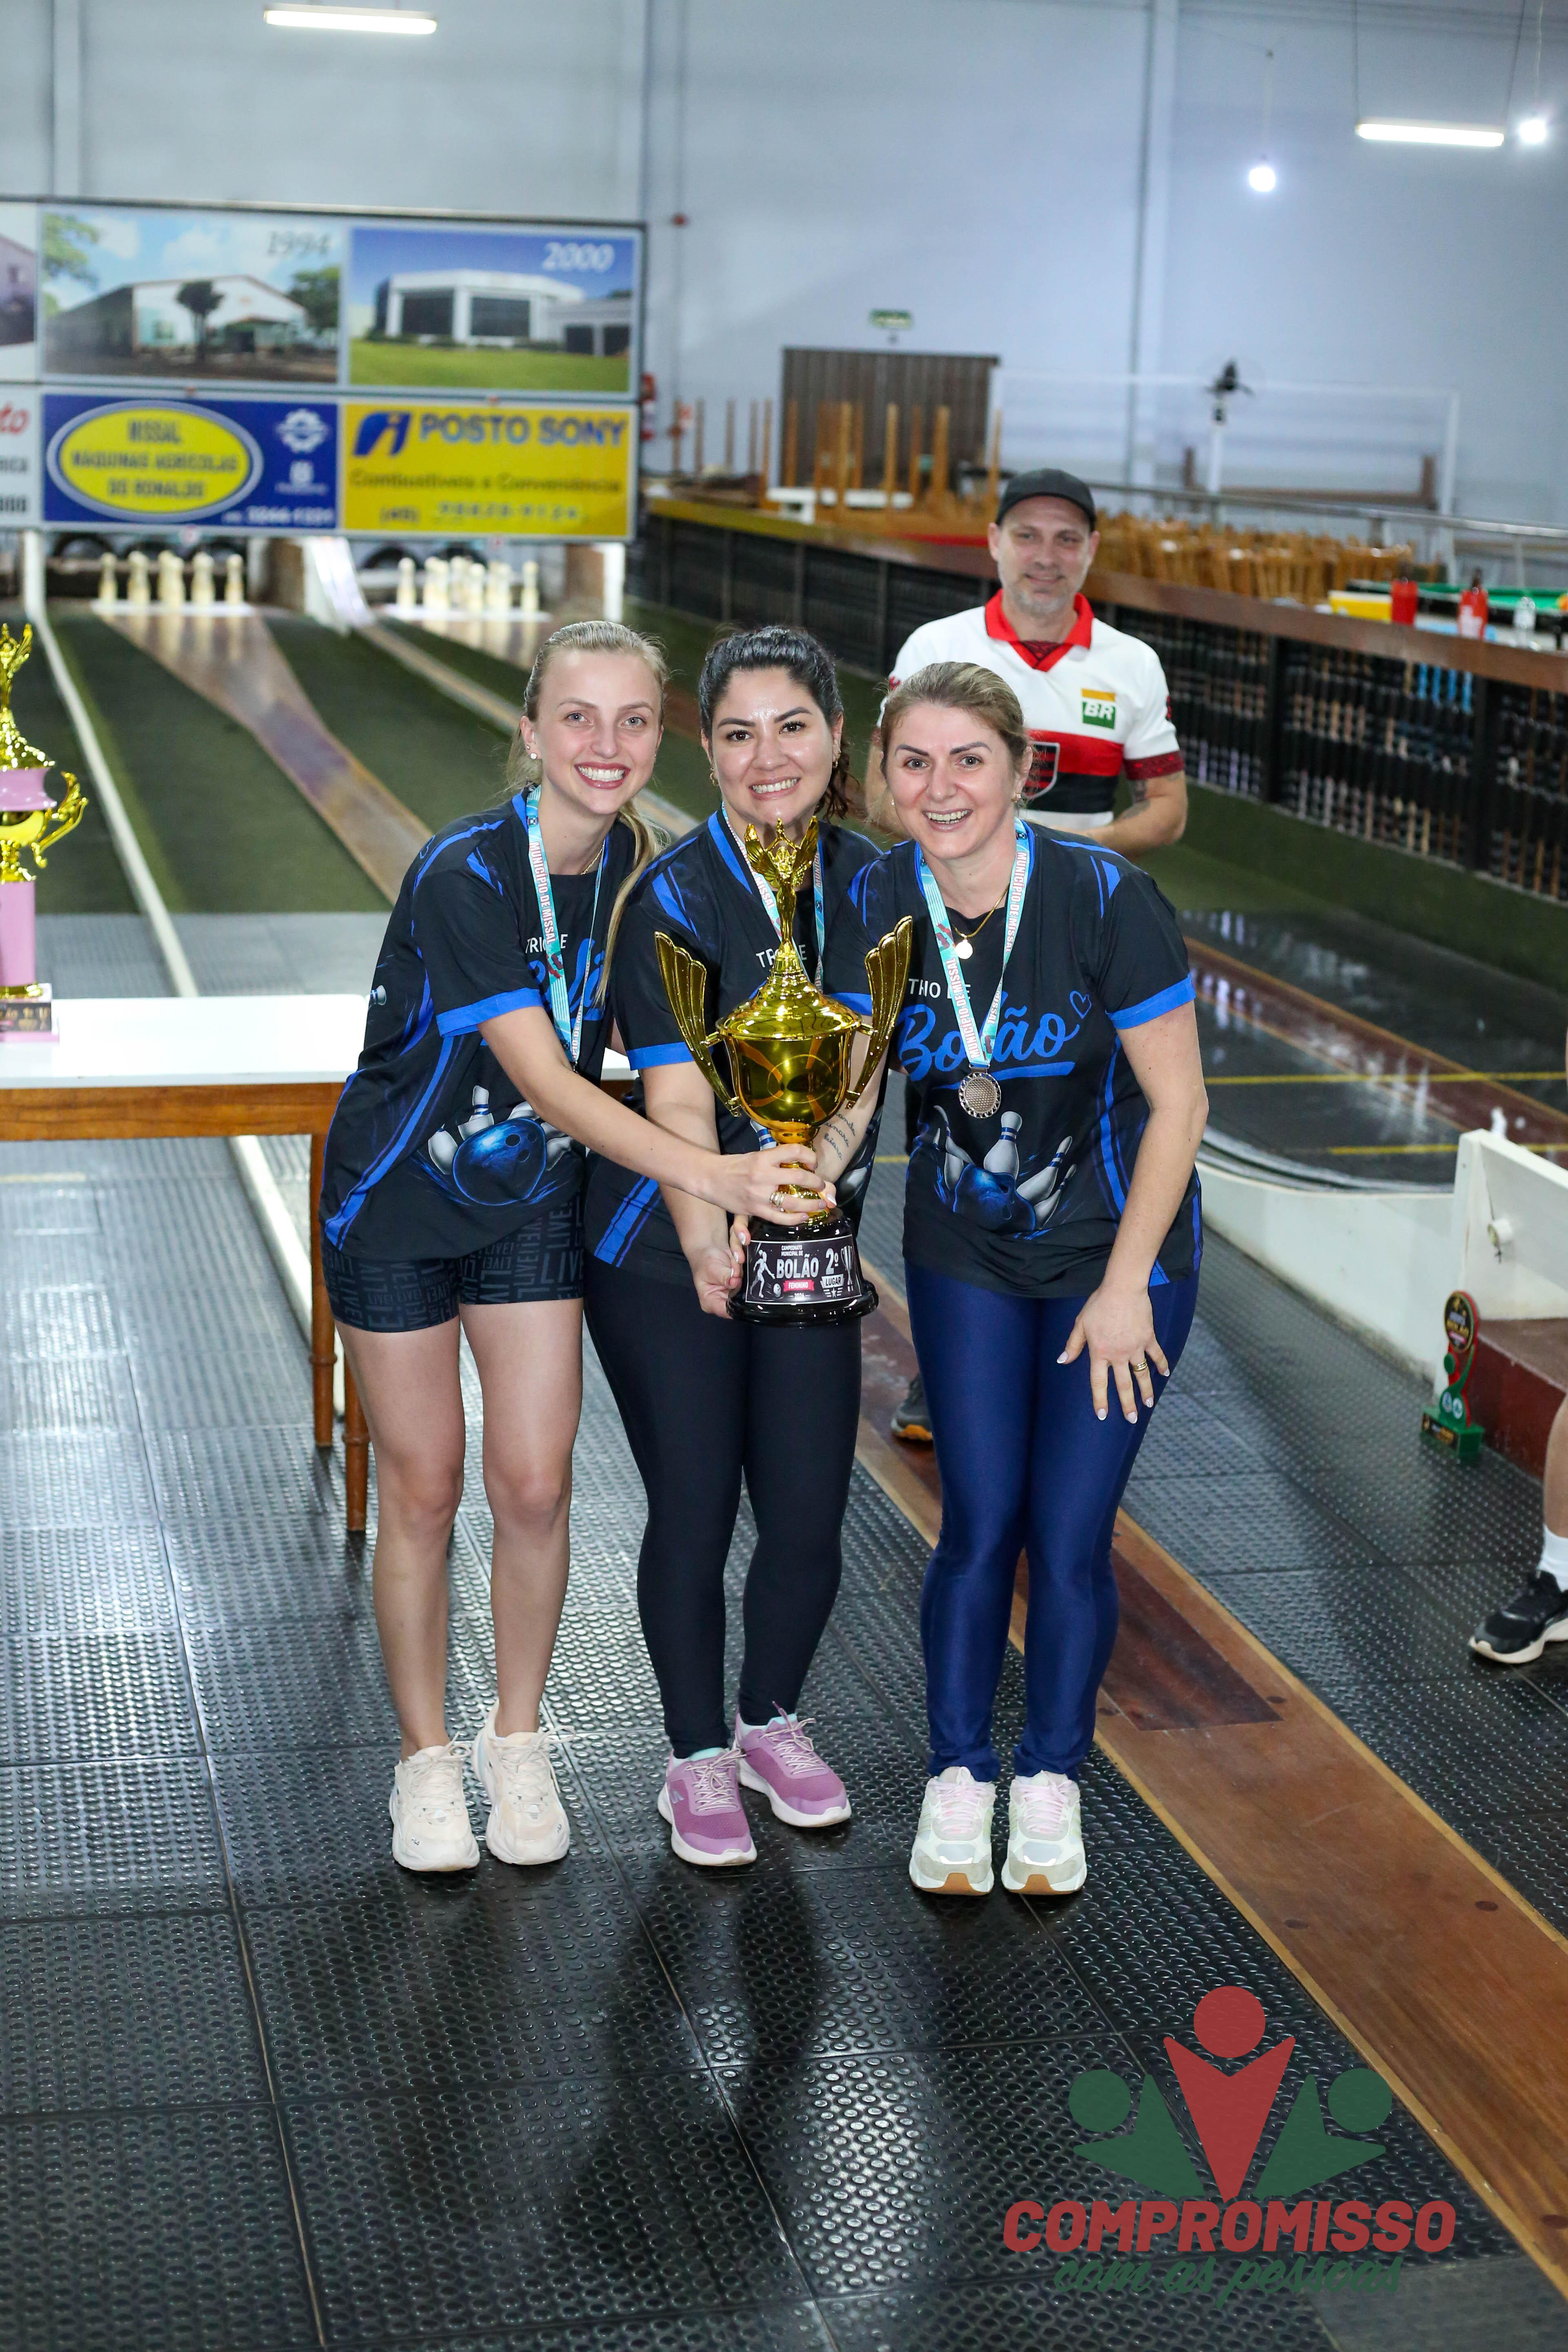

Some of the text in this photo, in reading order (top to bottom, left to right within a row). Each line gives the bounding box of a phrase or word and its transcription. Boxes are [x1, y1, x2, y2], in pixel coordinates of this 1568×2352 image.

[267, 230, 332, 258] 1994
[542, 242, 615, 272] 2000
[420, 413, 626, 446] POSTO SONY
[1084, 701, 1112, 720] BR
[529, 841, 556, 944] MUNICÍPIO DE MISSAL
[755, 876, 775, 910] MISSAL
[1005, 851, 1027, 953] MUNICÍPIO DE MISSAL
[945, 958, 981, 1060] MISSAL DE MUNICÍPIO
[776, 1254, 819, 1278] BOLÃO
[826, 1248, 839, 1275] 2º
[826, 1277, 842, 1286] LUGAR
